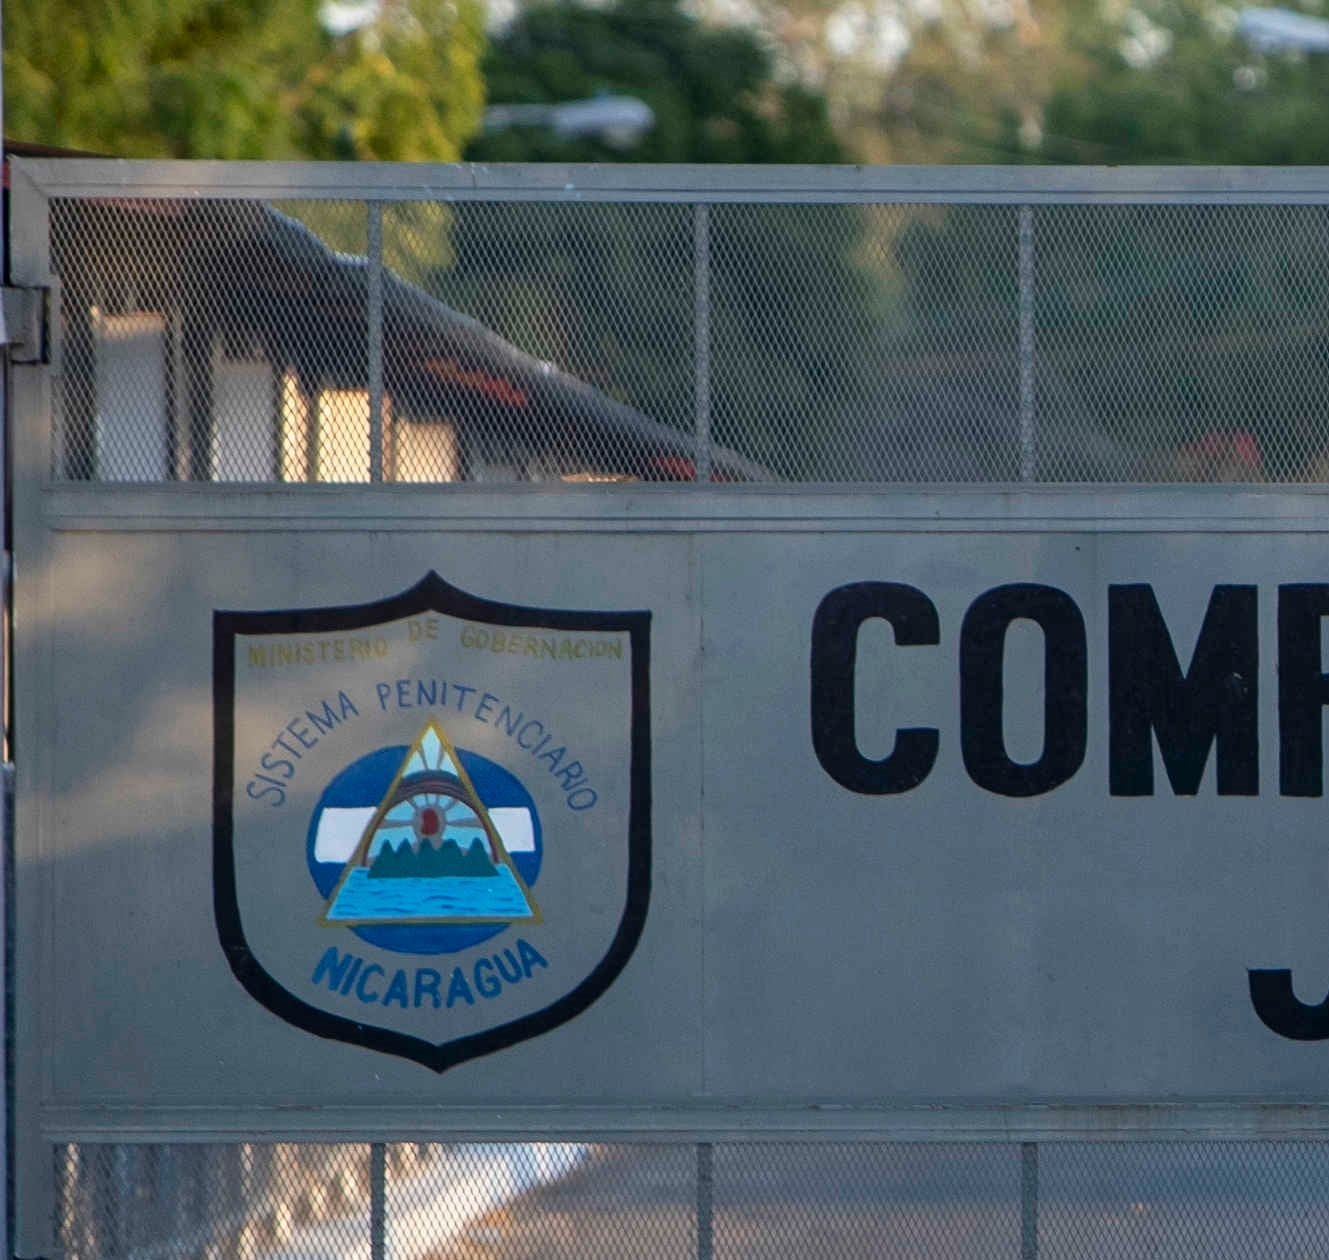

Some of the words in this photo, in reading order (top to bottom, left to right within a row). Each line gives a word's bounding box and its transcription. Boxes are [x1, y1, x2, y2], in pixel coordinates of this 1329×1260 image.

[408, 618, 441, 642] DE
[247, 690, 358, 807] SISTEMA
[376, 679, 598, 812] PENITENCIARIO
[312, 938, 550, 1009] NICARAGUA
